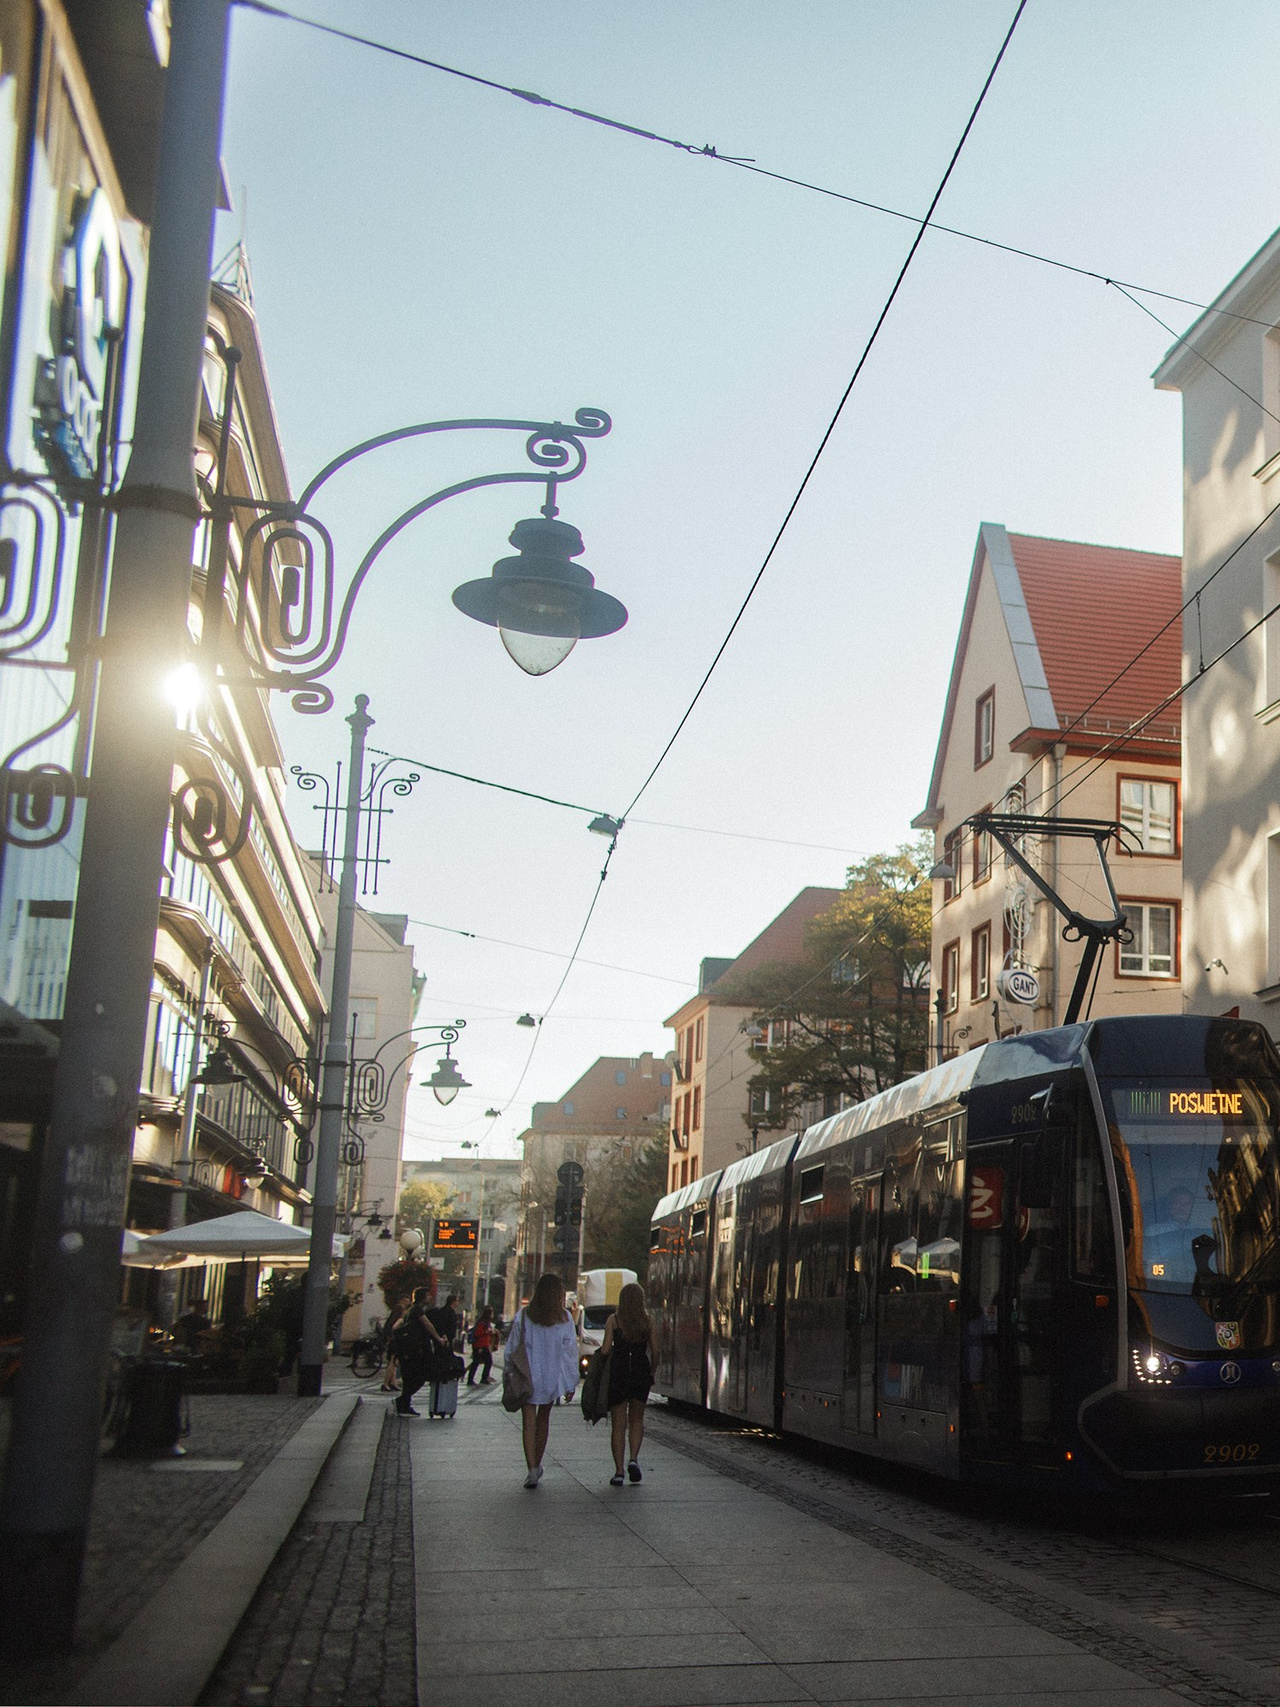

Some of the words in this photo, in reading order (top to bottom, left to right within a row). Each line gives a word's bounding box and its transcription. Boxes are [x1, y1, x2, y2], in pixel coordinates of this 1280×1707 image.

[1013, 977, 1035, 996] GANT
[1169, 1091, 1244, 1115] POŚWIĘTNE
[1152, 1264, 1165, 1276] 05
[1203, 1443, 1262, 1464] 2902
